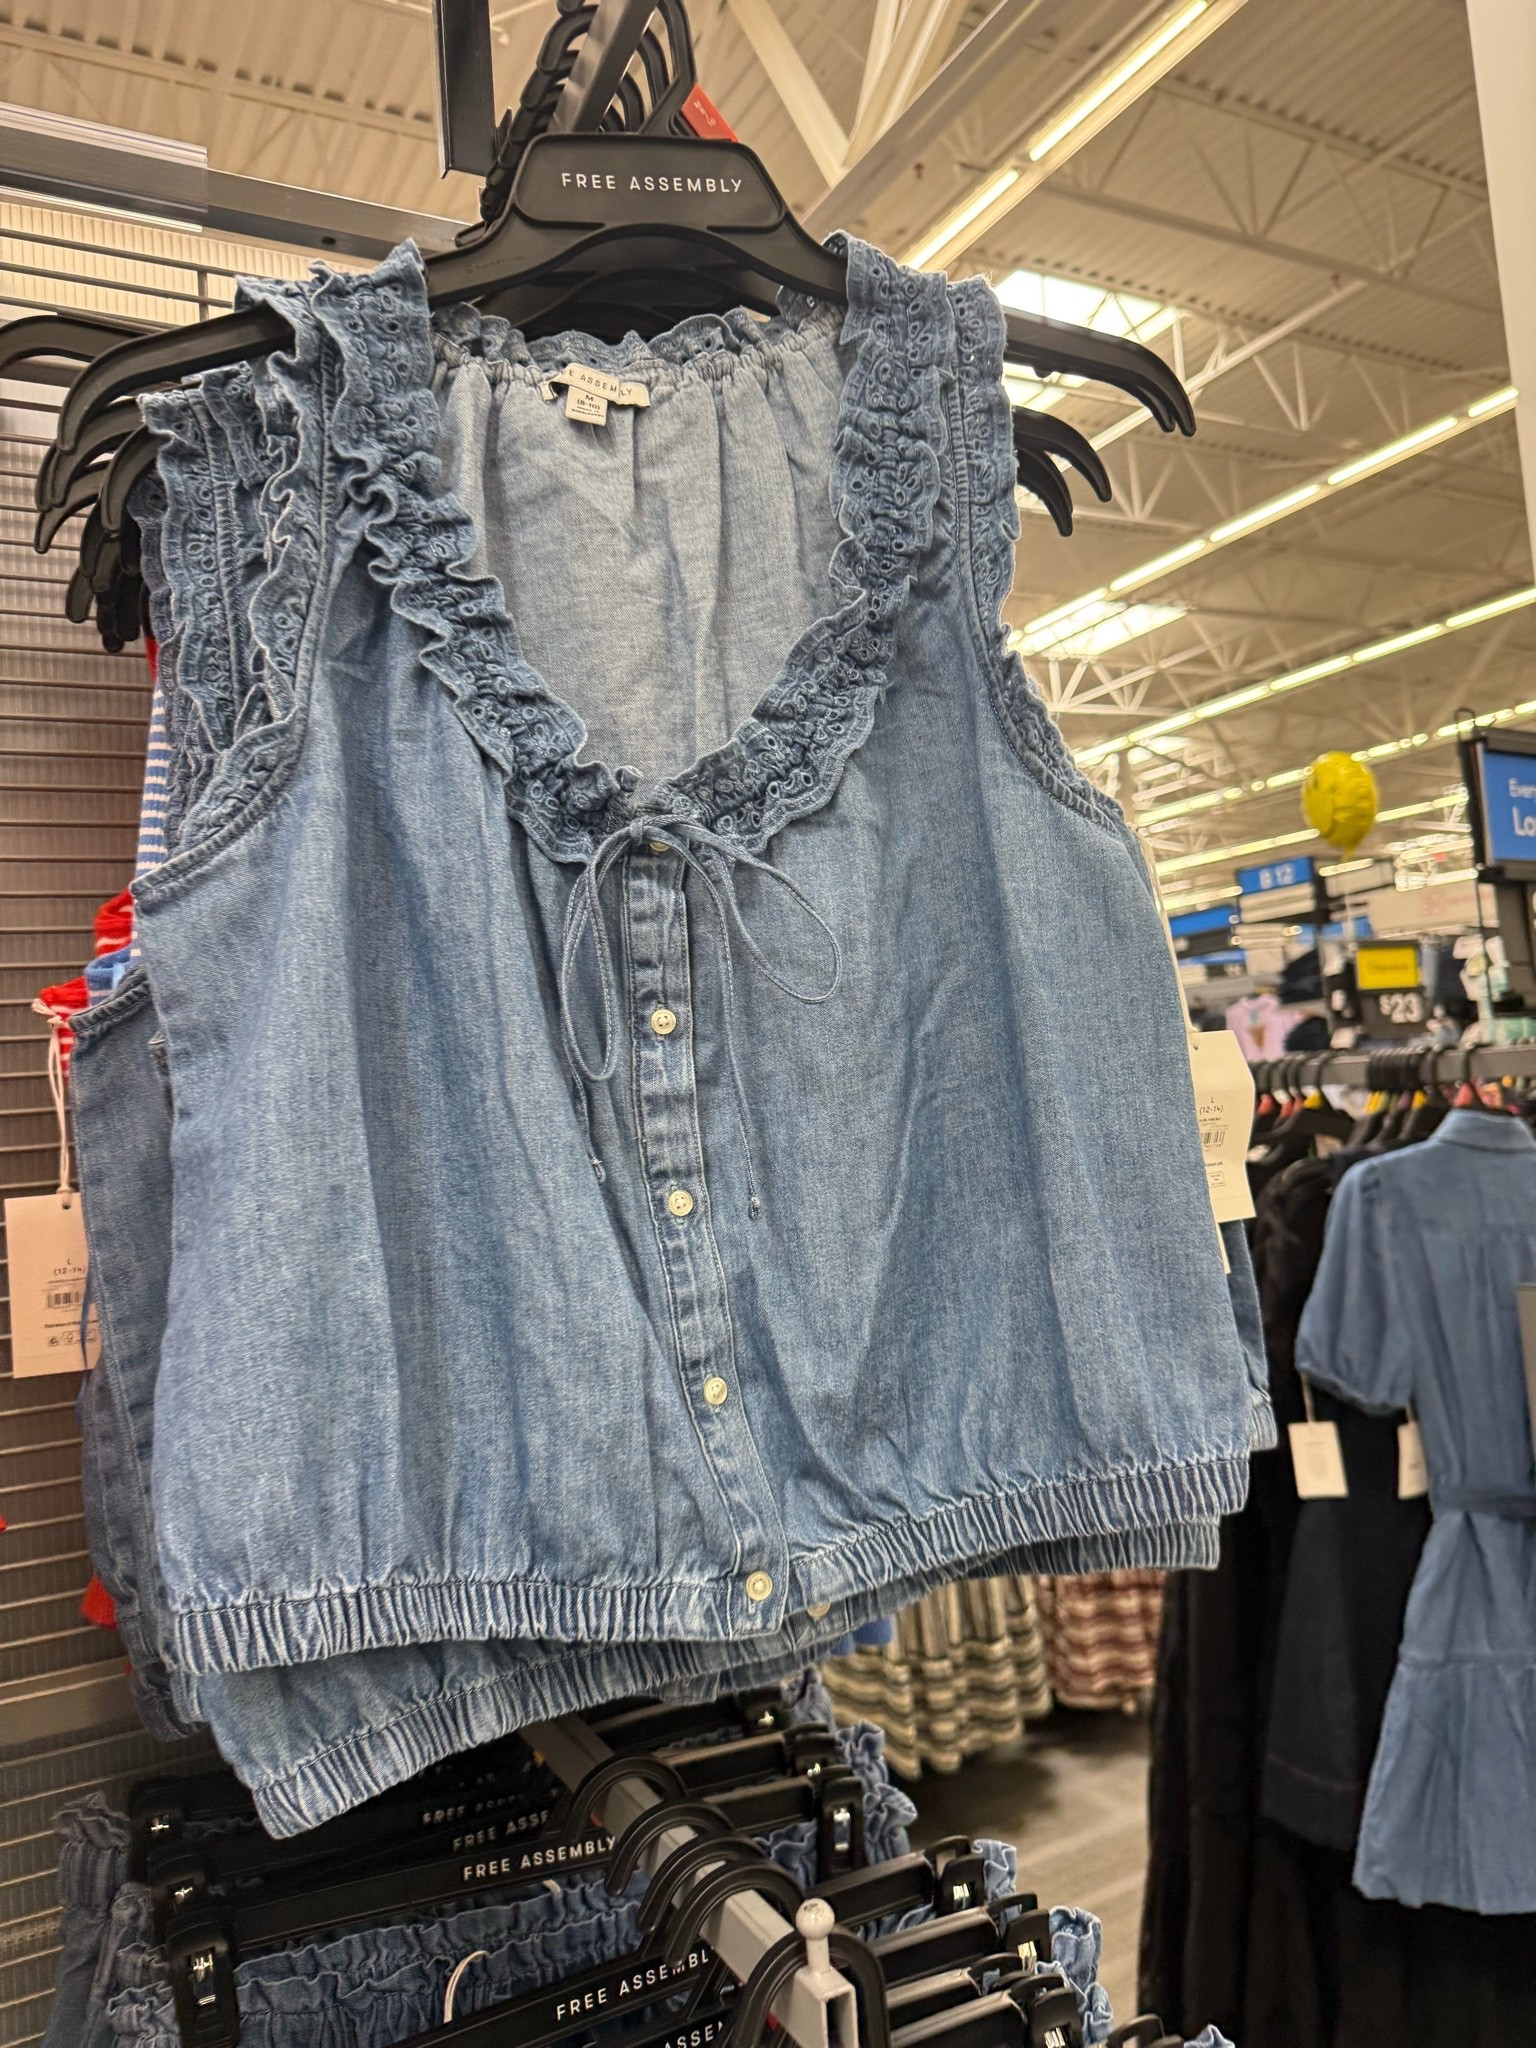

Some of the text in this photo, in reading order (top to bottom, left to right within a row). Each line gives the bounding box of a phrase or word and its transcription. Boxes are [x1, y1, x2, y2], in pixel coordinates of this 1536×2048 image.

[561, 172, 742, 193] FREE ASSEMBLY
[585, 394, 594, 402] M
[1199, 1104, 1224, 1115] (12-14)
[452, 1826, 497, 1851] FREE
[462, 1835, 616, 1881] FREE ASSEMBLY
[556, 1987, 607, 2021] FREE
